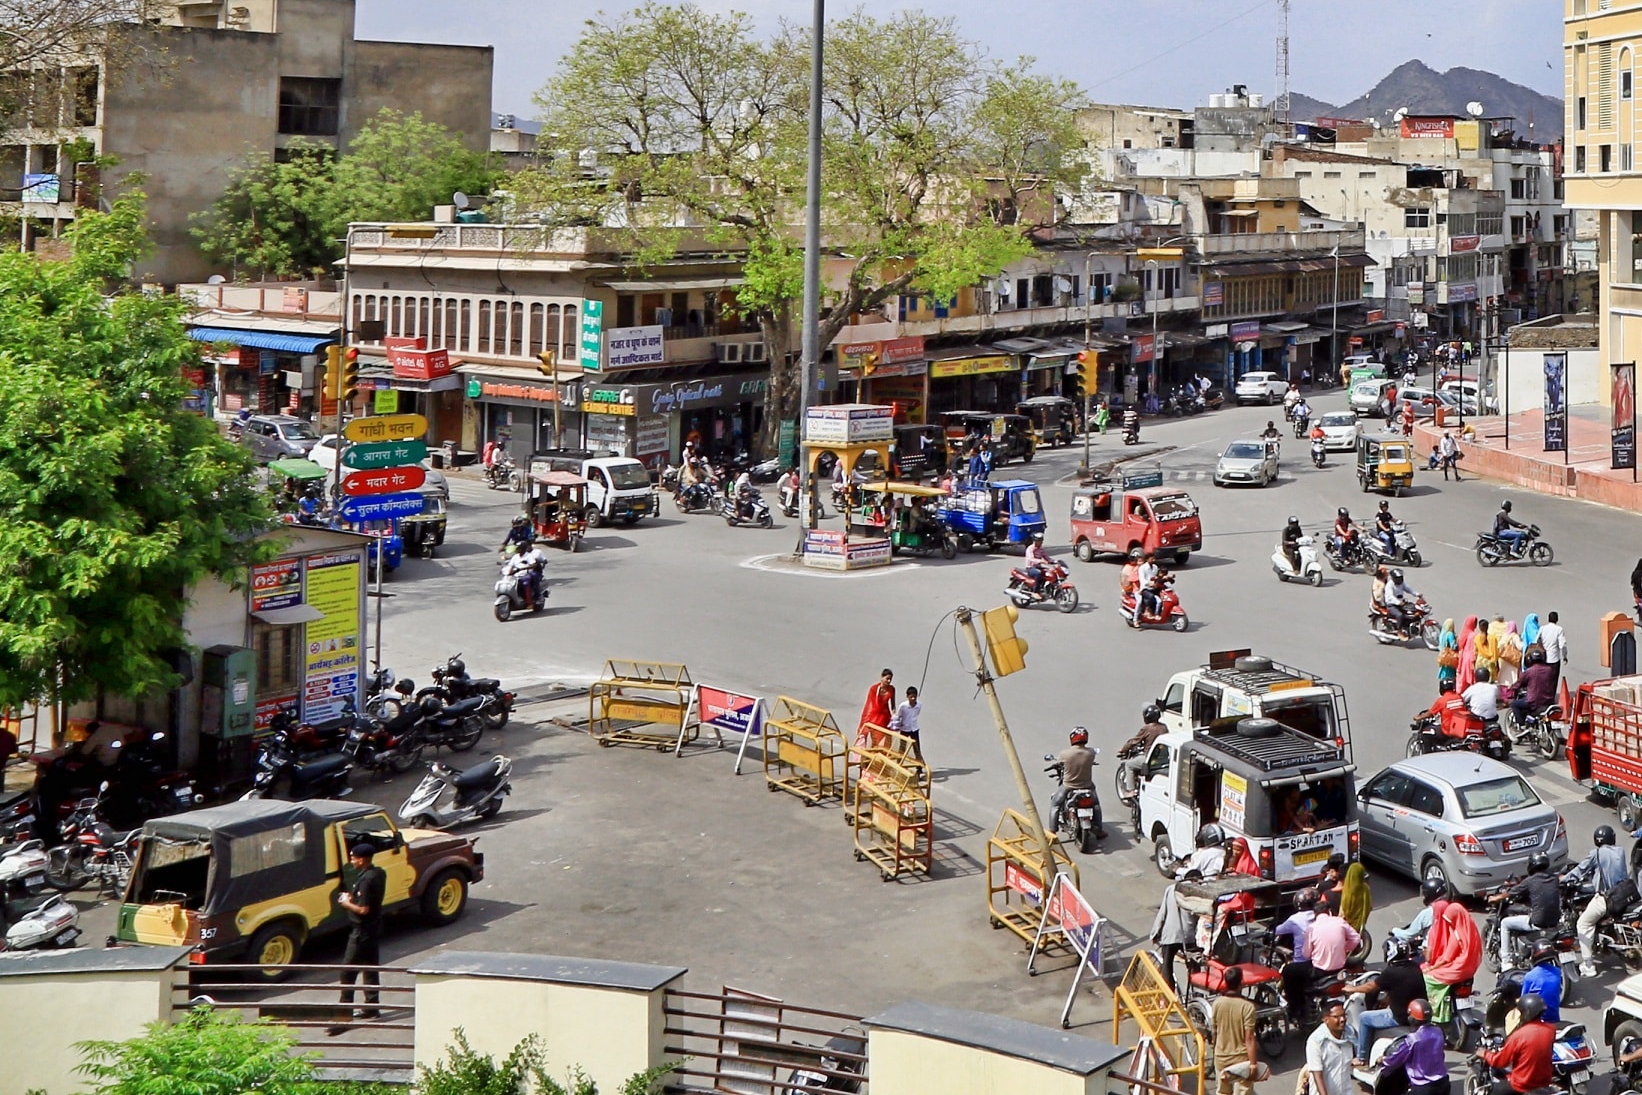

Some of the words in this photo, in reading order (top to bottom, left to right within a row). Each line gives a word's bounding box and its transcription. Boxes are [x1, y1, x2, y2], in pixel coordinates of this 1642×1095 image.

[1415, 121, 1450, 131] KINGFISHER
[400, 357, 415, 366] airtel
[416, 358, 425, 368] 4G
[434, 361, 445, 369] 4G
[359, 421, 385, 437] गांधी
[388, 422, 415, 435] भवन
[363, 450, 392, 461] आगरा
[395, 447, 409, 459] गेट
[366, 477, 388, 488] मदार
[392, 474, 406, 486] गेट
[1290, 833, 1334, 850] SPARTAN
